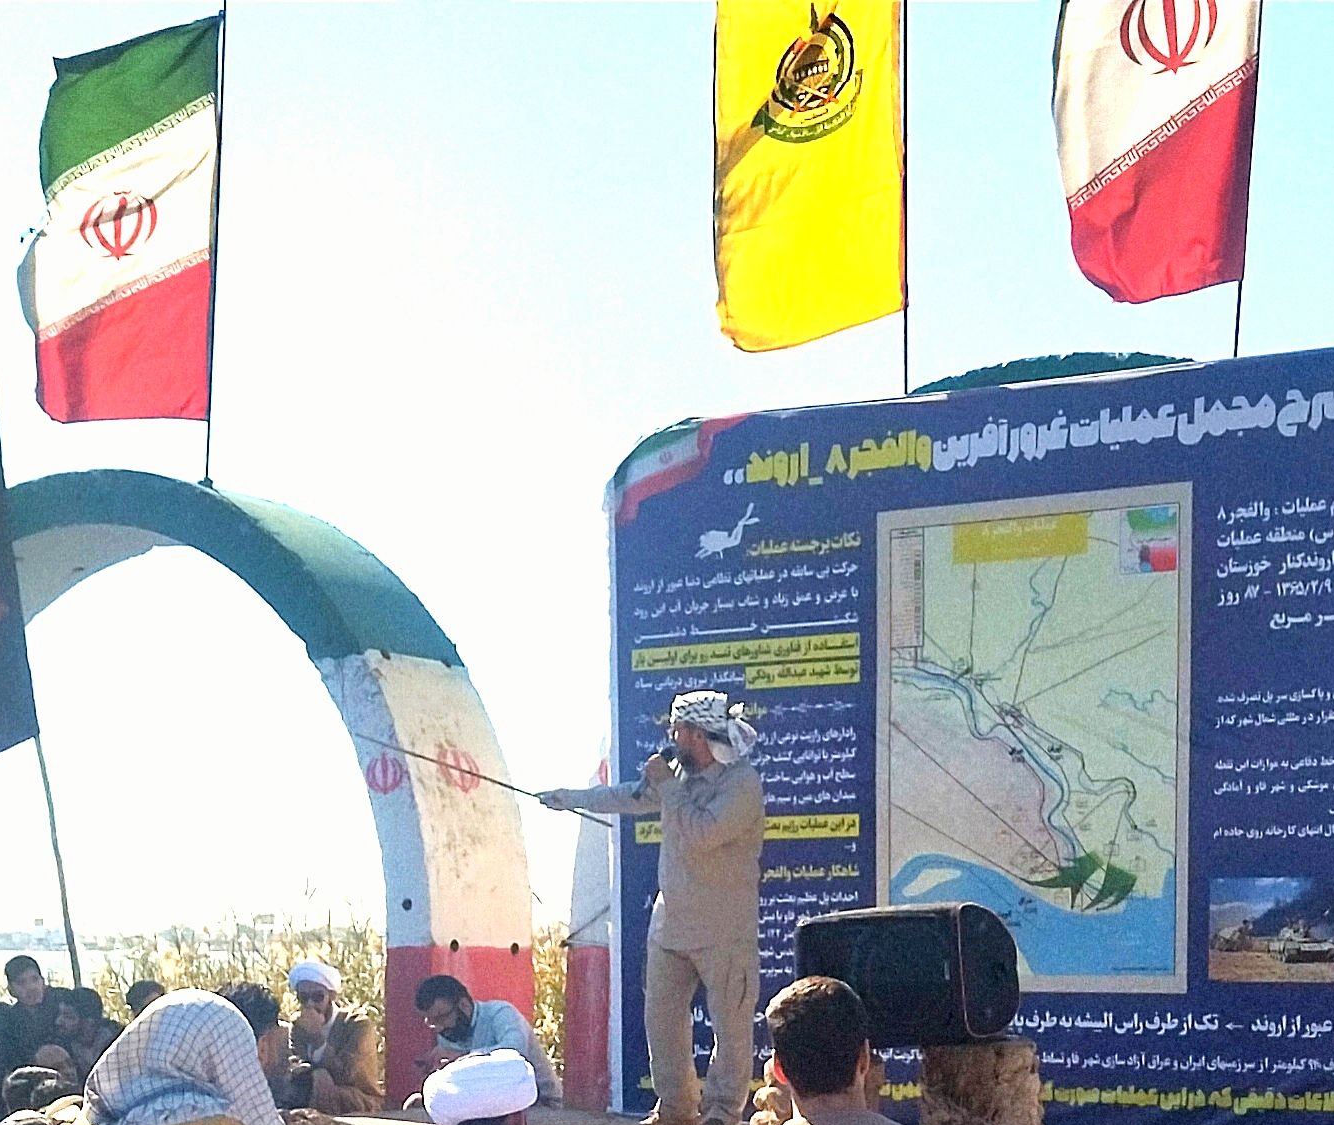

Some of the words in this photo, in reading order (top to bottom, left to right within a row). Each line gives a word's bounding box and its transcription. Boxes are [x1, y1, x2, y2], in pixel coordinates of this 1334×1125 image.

[1069, 404, 1176, 450] عملیات
[1177, 394, 1276, 445] مجمل
[847, 429, 932, 480] والفجر
[1217, 507, 1226, 519] ۸
[1227, 501, 1270, 524] والفجر
[1282, 497, 1326, 516] عملیات
[831, 531, 861, 548] نکات
[1217, 530, 1261, 547] عملیات
[1266, 526, 1305, 542] منطقه
[790, 539, 830, 554] برجسته
[1217, 558, 1271, 577] خوزستان
[1218, 592, 1240, 606] روز
[1026, 1010, 1057, 1032] طرف
[1059, 1016, 1072, 1027] به
[1115, 1013, 1143, 1034] راس
[1146, 1013, 1179, 1035] طرف
[1180, 1013, 1192, 1035] از
[1194, 1014, 1219, 1030] تک
[1251, 1015, 1287, 1037] اروند
[1288, 1015, 1301, 1037] از
[1301, 1020, 1332, 1038] عبور
